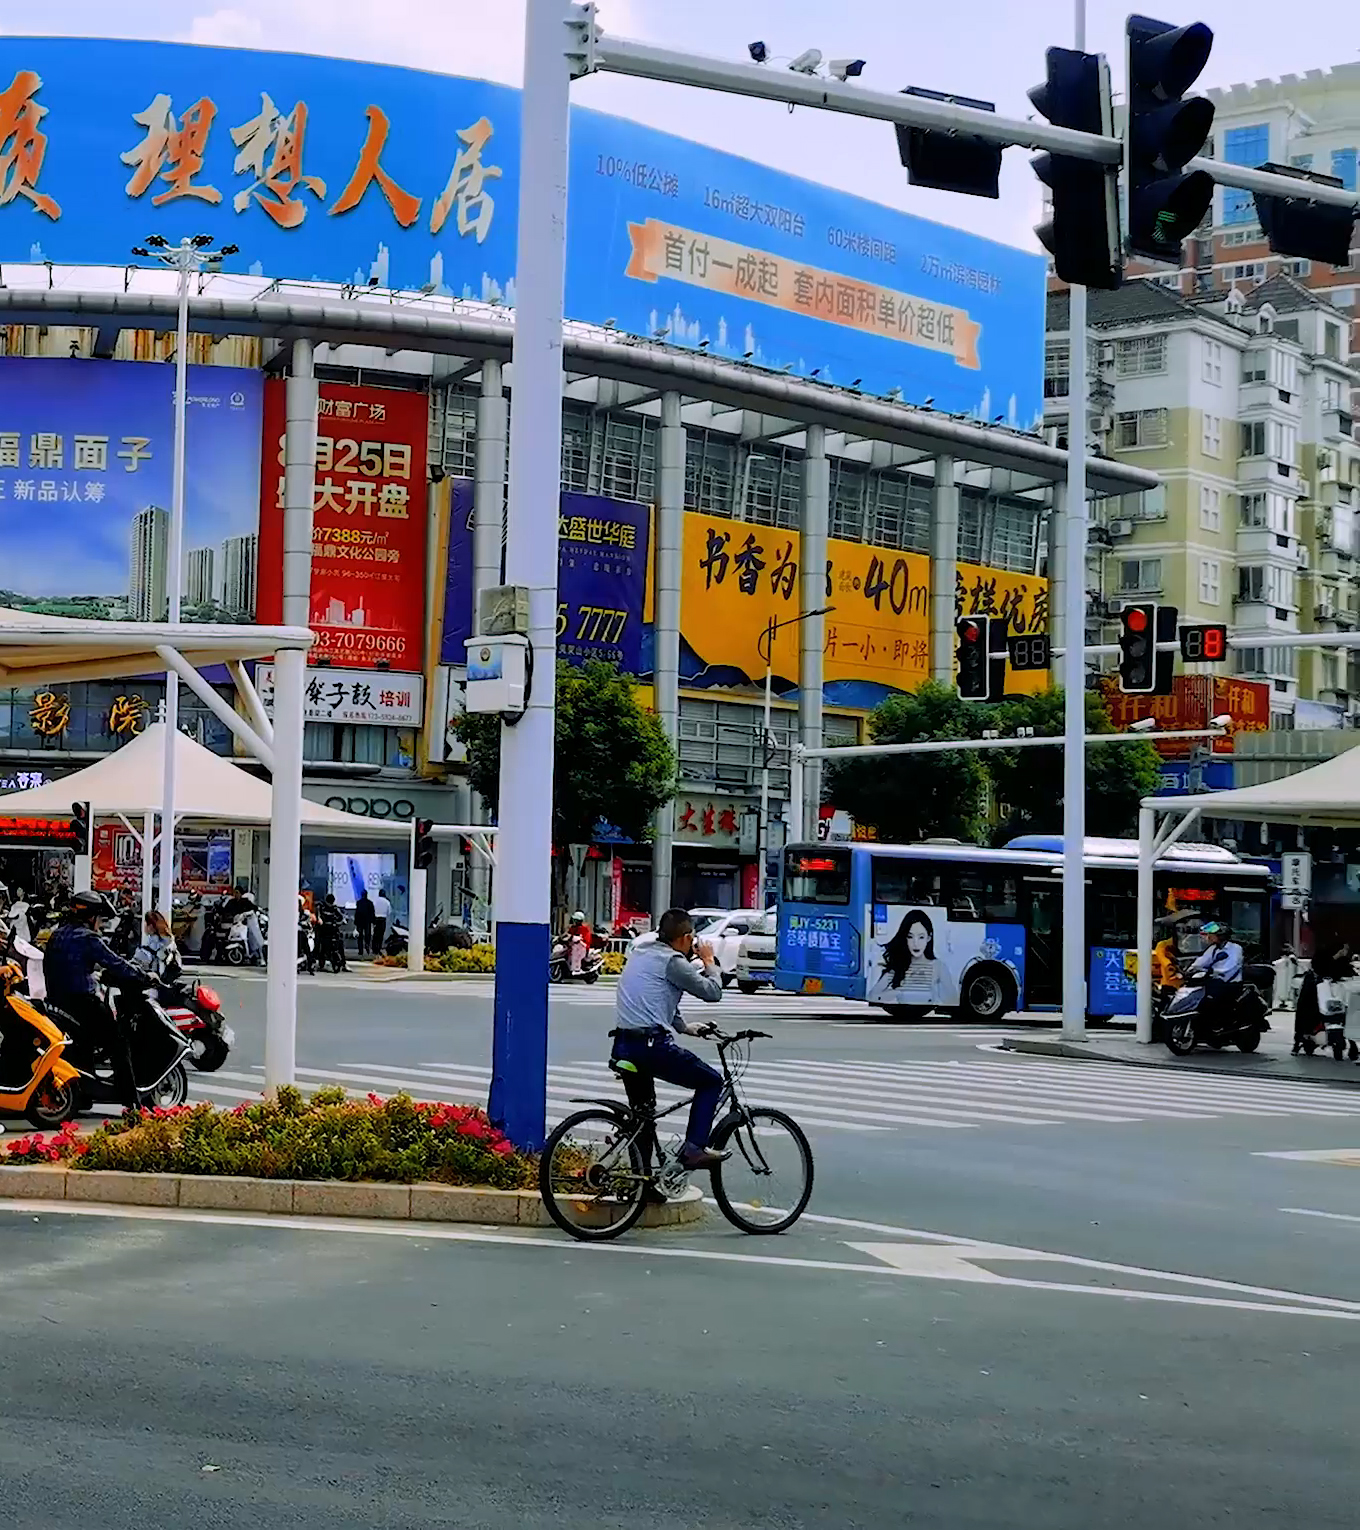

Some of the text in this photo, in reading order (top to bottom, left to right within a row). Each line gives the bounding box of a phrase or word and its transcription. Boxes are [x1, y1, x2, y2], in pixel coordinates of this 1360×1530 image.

[121, 91, 503, 245] 理想人居
[663, 231, 955, 347] 首付一成起 套内面积单价超低
[13, 478, 106, 503] 新品认筹
[276, 477, 410, 520] 大开盘
[699, 527, 832, 601] 书香为
[576, 605, 628, 644] 7777
[379, 689, 411, 708] 培训
[324, 796, 415, 819] OPPO
